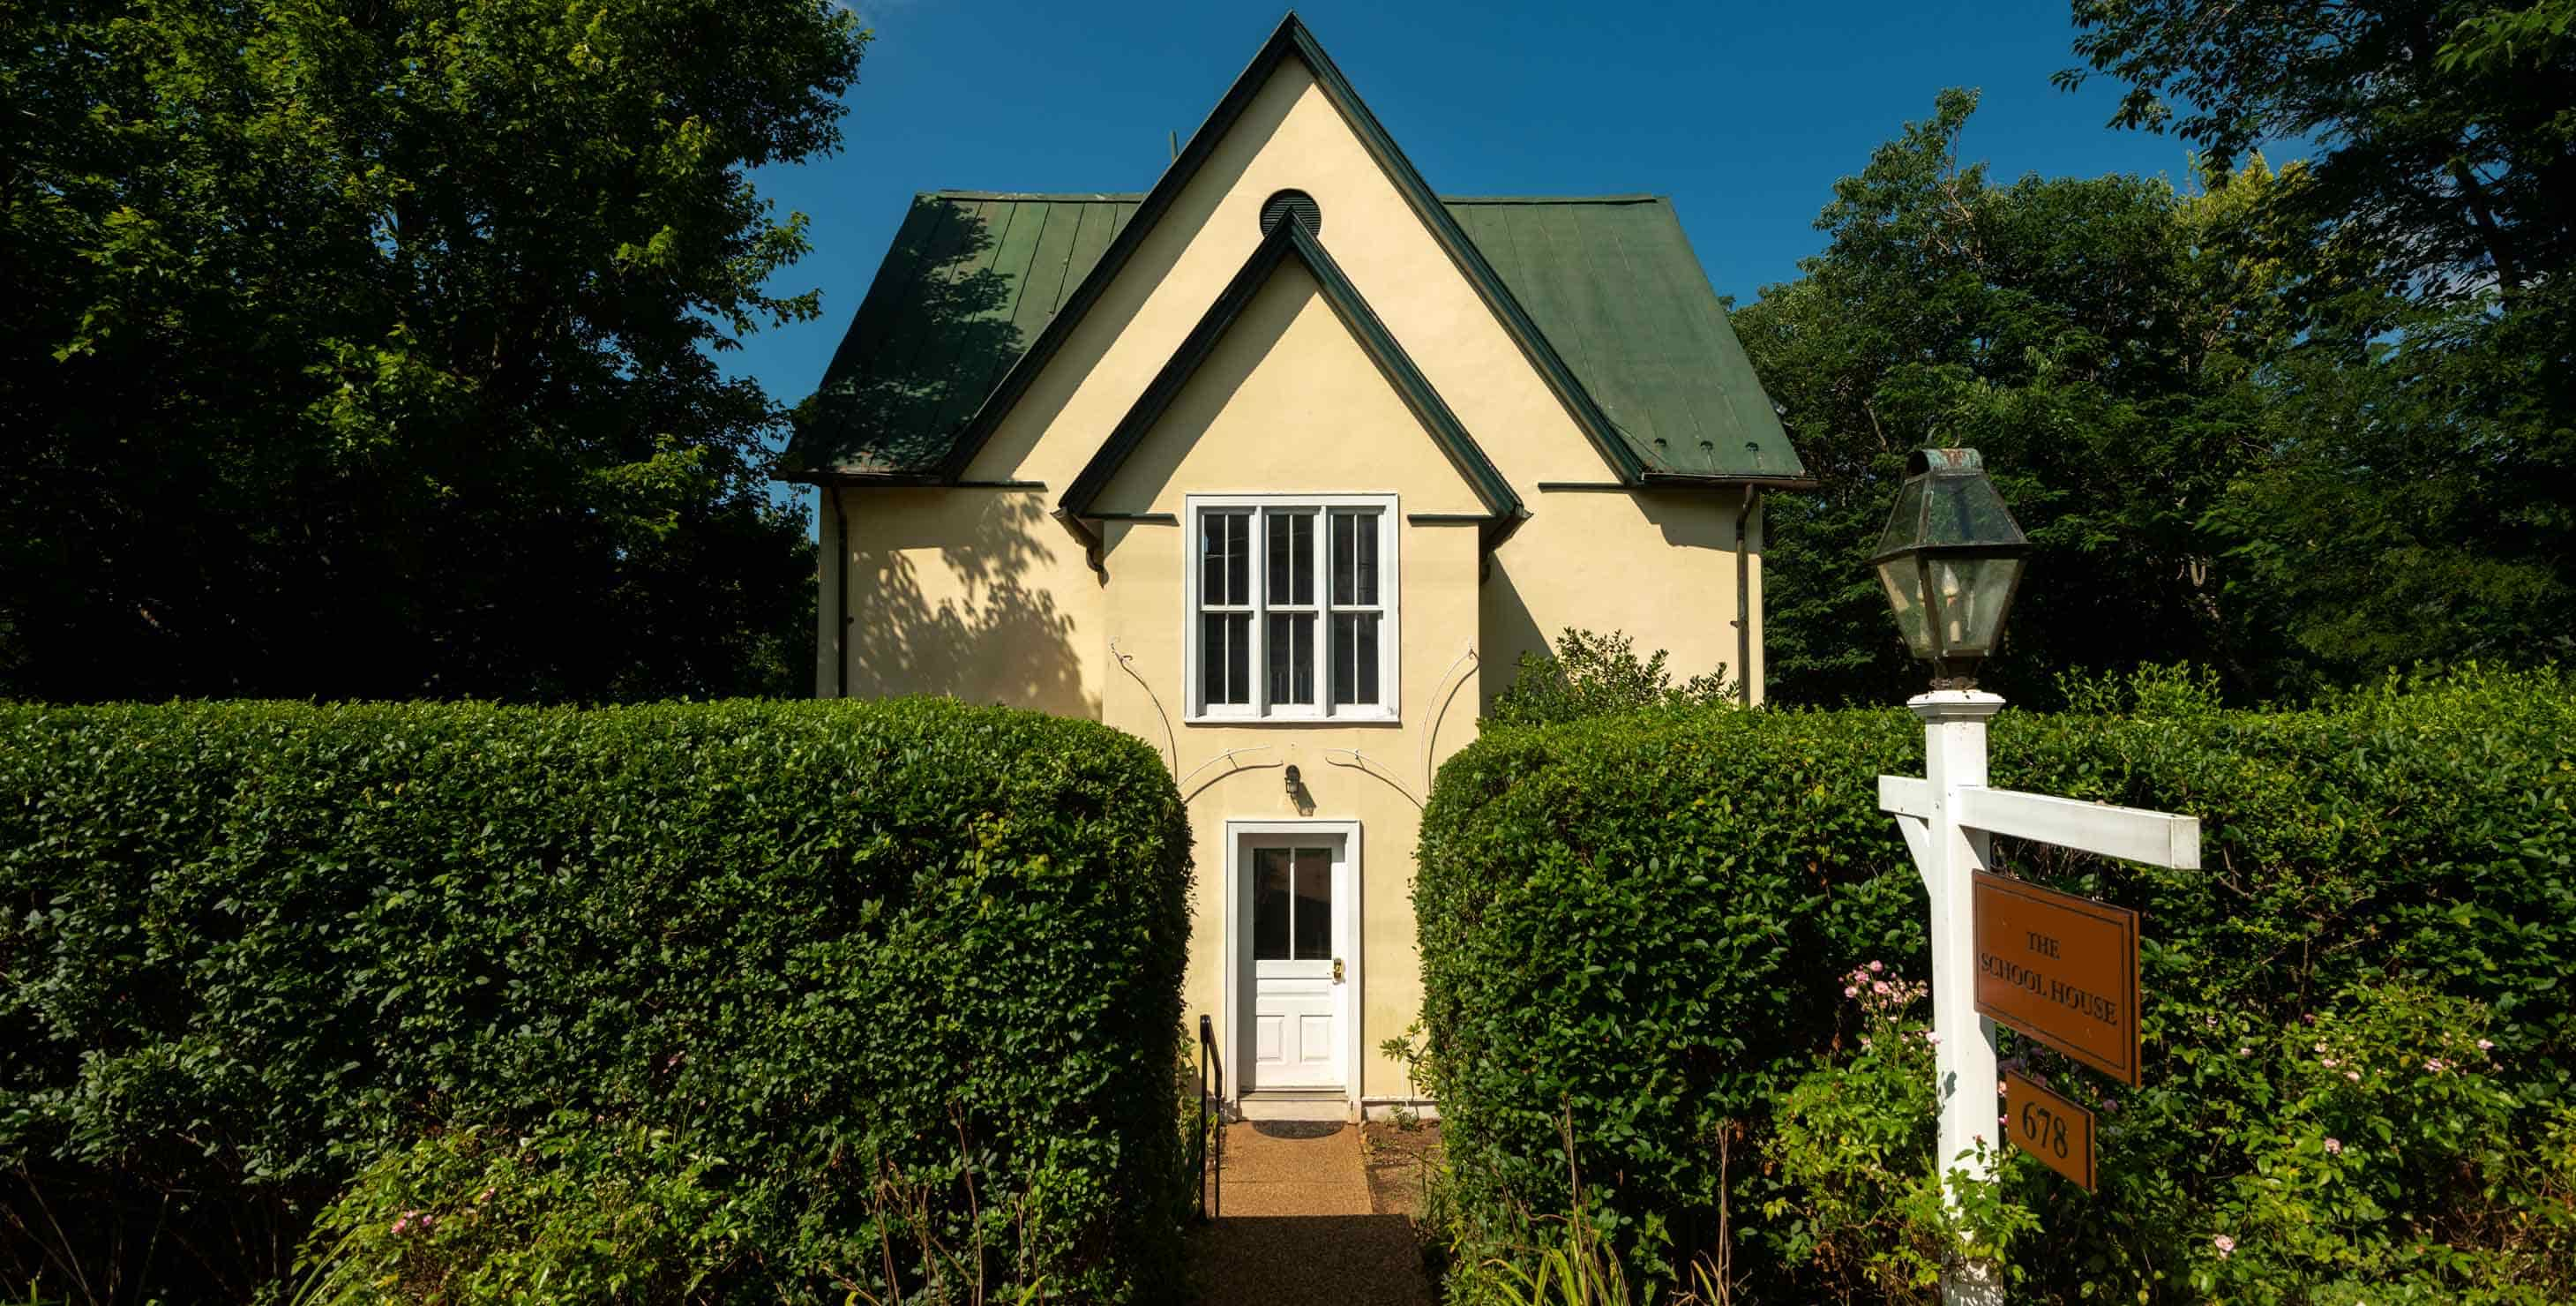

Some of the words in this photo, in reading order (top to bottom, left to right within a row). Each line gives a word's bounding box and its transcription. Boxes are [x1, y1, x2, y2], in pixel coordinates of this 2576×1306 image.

[2026, 932, 2061, 959] THE
[1981, 952, 2047, 996] SCHOOL
[2051, 980, 2117, 1025] HOUSE
[2023, 1102, 2068, 1159] 678
